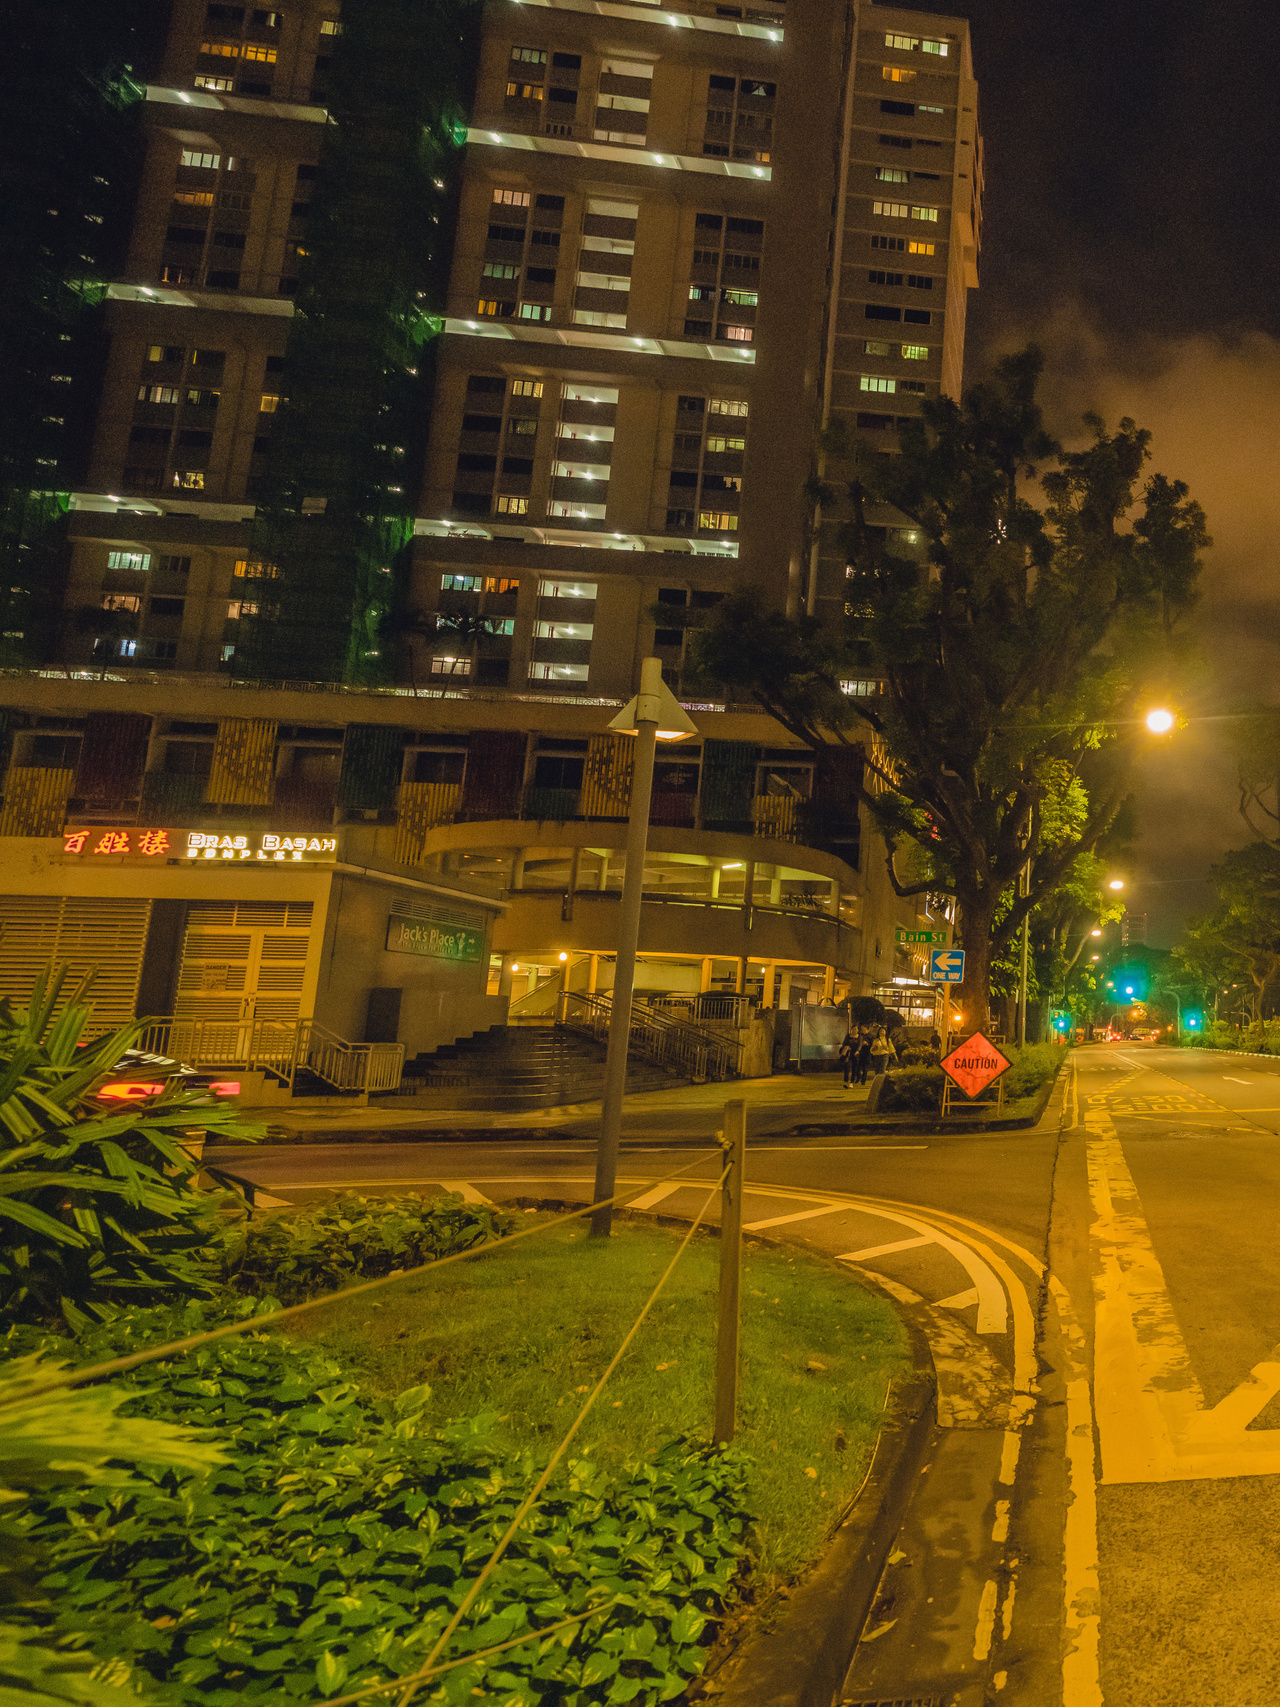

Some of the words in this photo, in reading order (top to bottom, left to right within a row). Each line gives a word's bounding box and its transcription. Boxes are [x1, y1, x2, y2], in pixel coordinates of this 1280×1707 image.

[398, 923, 428, 943] Jack's
[430, 929, 455, 947] Place
[900, 932, 927, 942] Bain
[932, 932, 944, 942] St
[932, 971, 946, 980] ONE
[948, 972, 961, 980] WAY
[954, 1058, 998, 1070] CAUTION
